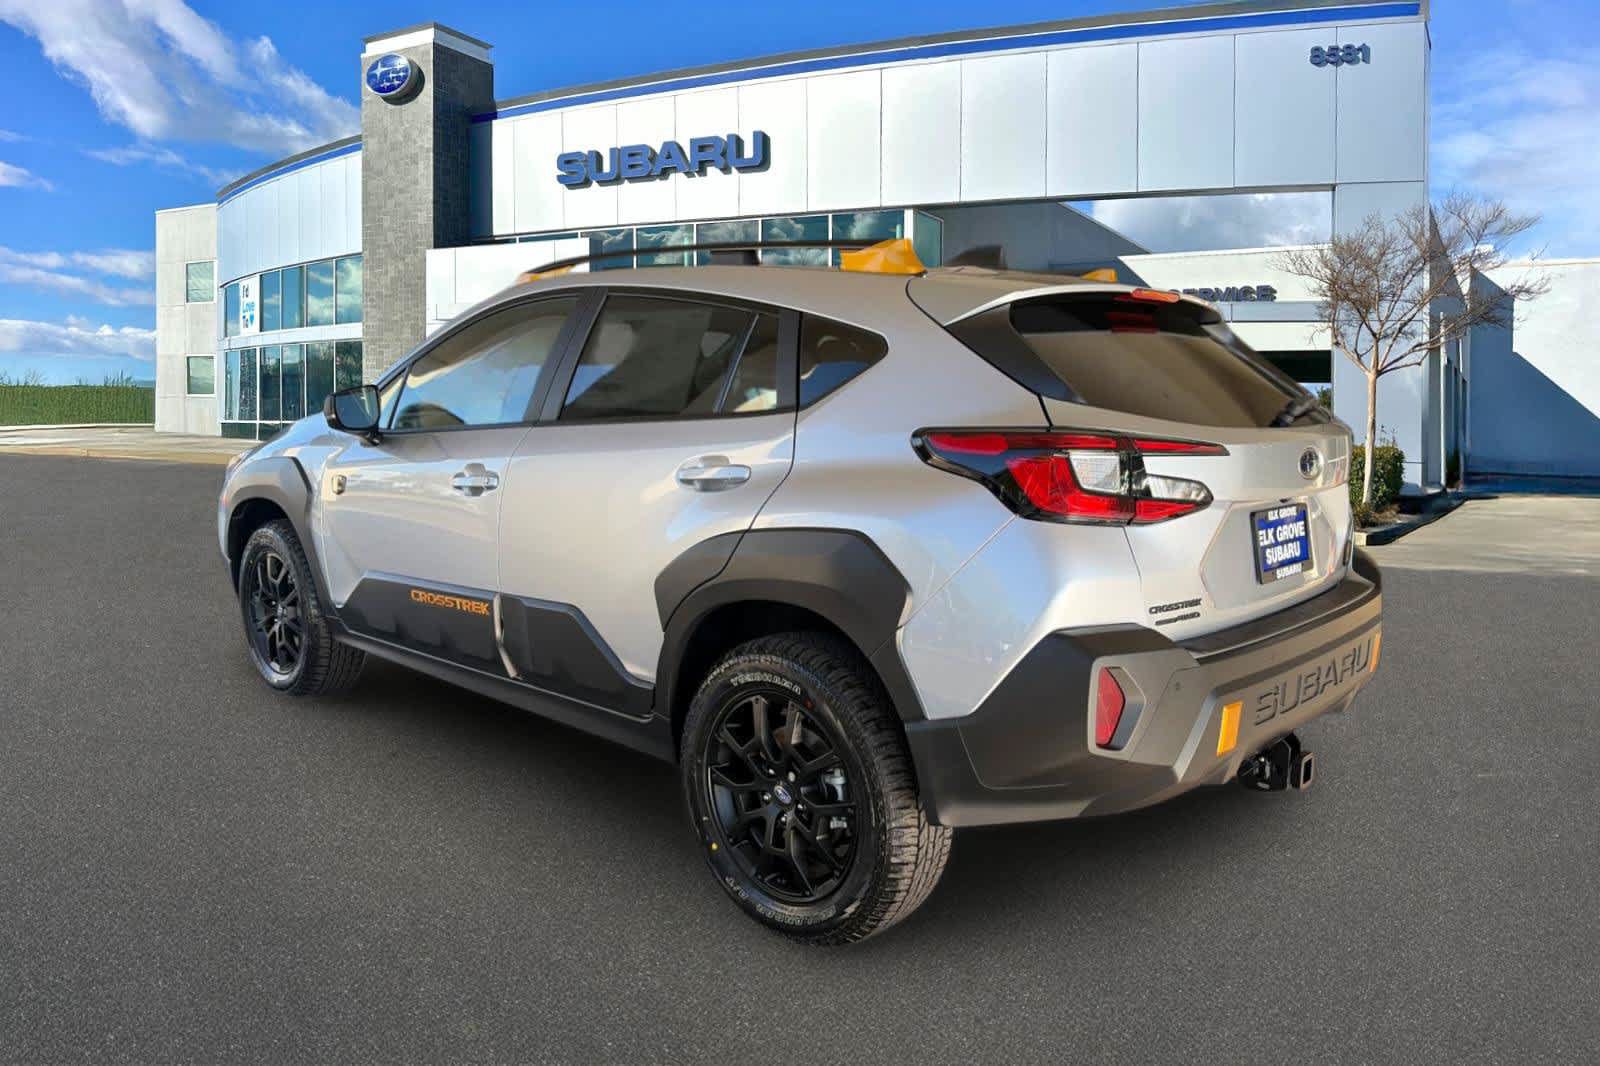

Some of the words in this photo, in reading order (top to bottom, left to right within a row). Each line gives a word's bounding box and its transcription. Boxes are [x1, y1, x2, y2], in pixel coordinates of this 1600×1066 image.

[556, 130, 771, 190] SUBARU
[1169, 285, 1277, 302] ERVICE
[1258, 527, 1276, 546] ELK
[1276, 520, 1306, 542] GROVE
[1265, 541, 1301, 564] SUBARU
[1276, 562, 1302, 579] SUBARU
[410, 589, 490, 616] CROSSTREK
[1254, 639, 1372, 726] SUBARU
